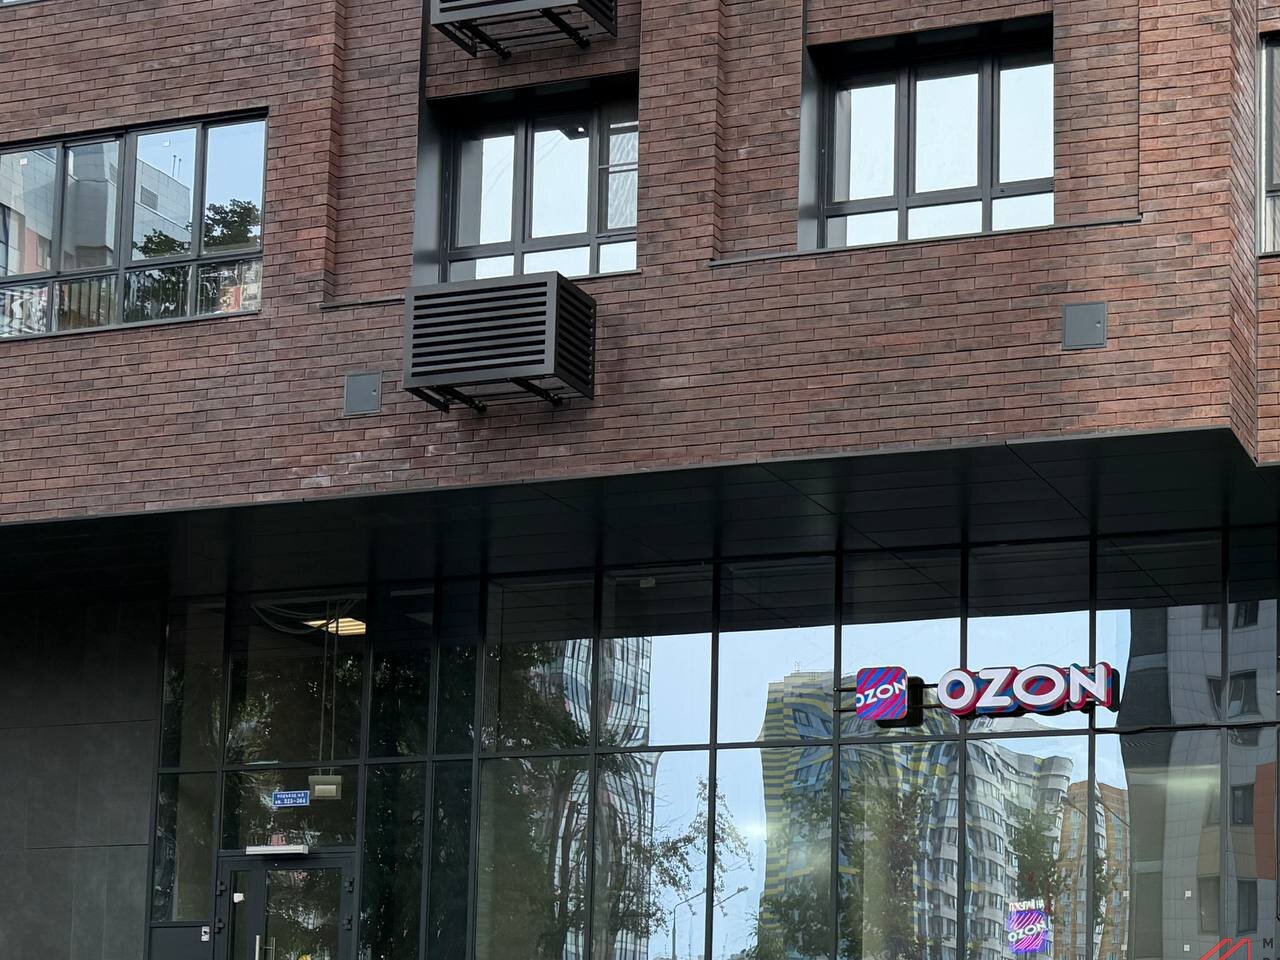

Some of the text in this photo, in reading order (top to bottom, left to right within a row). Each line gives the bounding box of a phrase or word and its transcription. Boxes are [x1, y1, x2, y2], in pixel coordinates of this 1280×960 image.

[856, 678, 907, 709] OZON
[937, 662, 1112, 714] OZON
[1007, 920, 1047, 942] OZON
